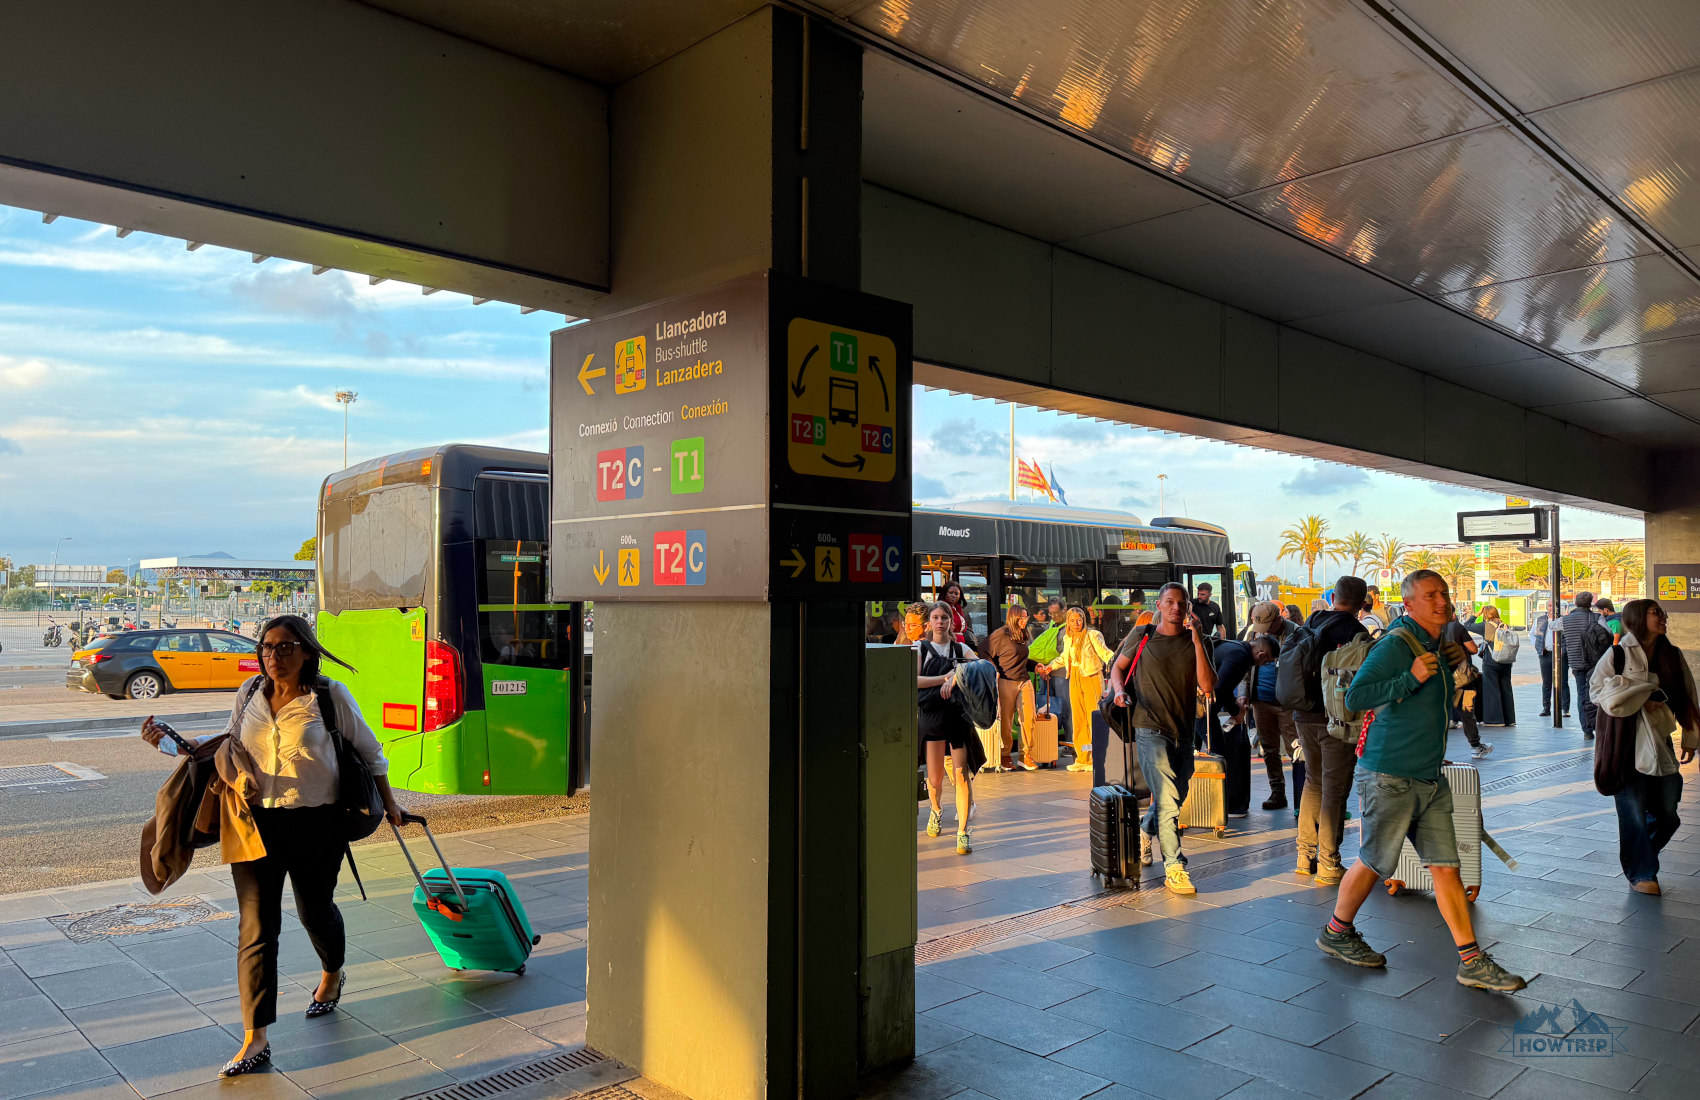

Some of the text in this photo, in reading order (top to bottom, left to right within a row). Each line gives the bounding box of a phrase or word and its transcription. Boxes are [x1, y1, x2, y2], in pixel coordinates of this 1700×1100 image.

[656, 310, 727, 341] Llançadora
[656, 337, 708, 363] Bus-shuttle
[833, 340, 855, 365] T1
[656, 359, 723, 386] Lanzadera
[579, 398, 728, 437] Connexió Connection Conexión
[674, 449, 701, 482] T1
[494, 683, 526, 692] 101215
